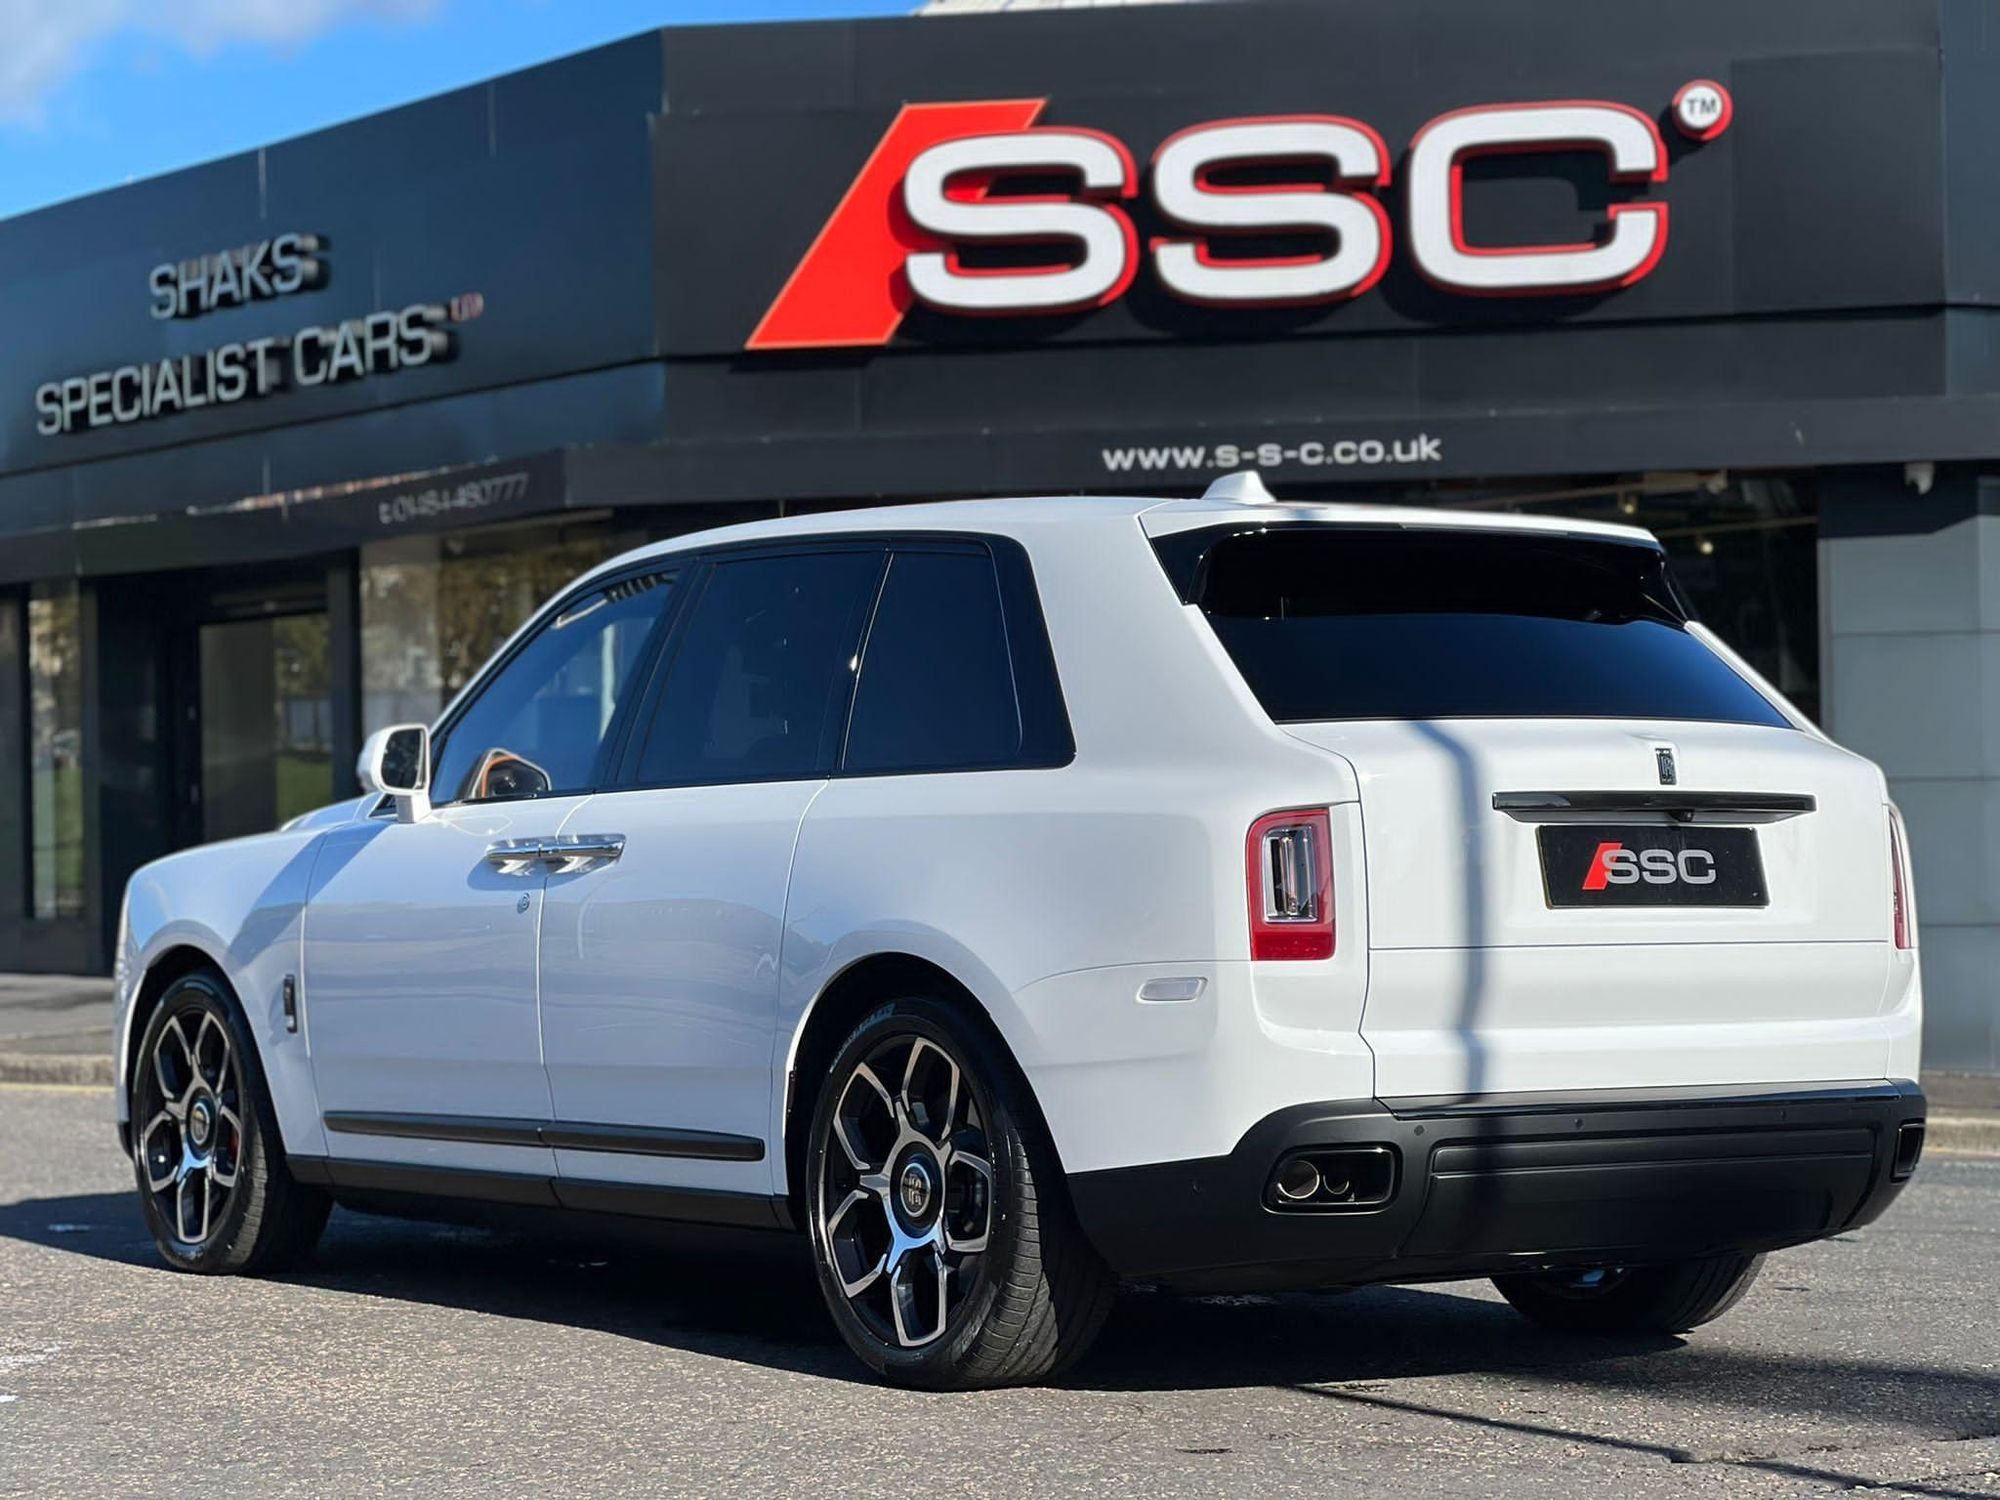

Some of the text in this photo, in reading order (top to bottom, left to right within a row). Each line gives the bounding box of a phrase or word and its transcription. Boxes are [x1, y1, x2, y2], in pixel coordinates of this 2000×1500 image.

[1686, 97, 1718, 117] TM
[902, 99, 1668, 311] SSC
[149, 232, 306, 321] SHAKS
[35, 336, 276, 436] SPECIALIST
[293, 303, 438, 386] CARS
[1101, 432, 1443, 472] www.s-s-c.co.uk
[1601, 848, 1717, 886] SSC
